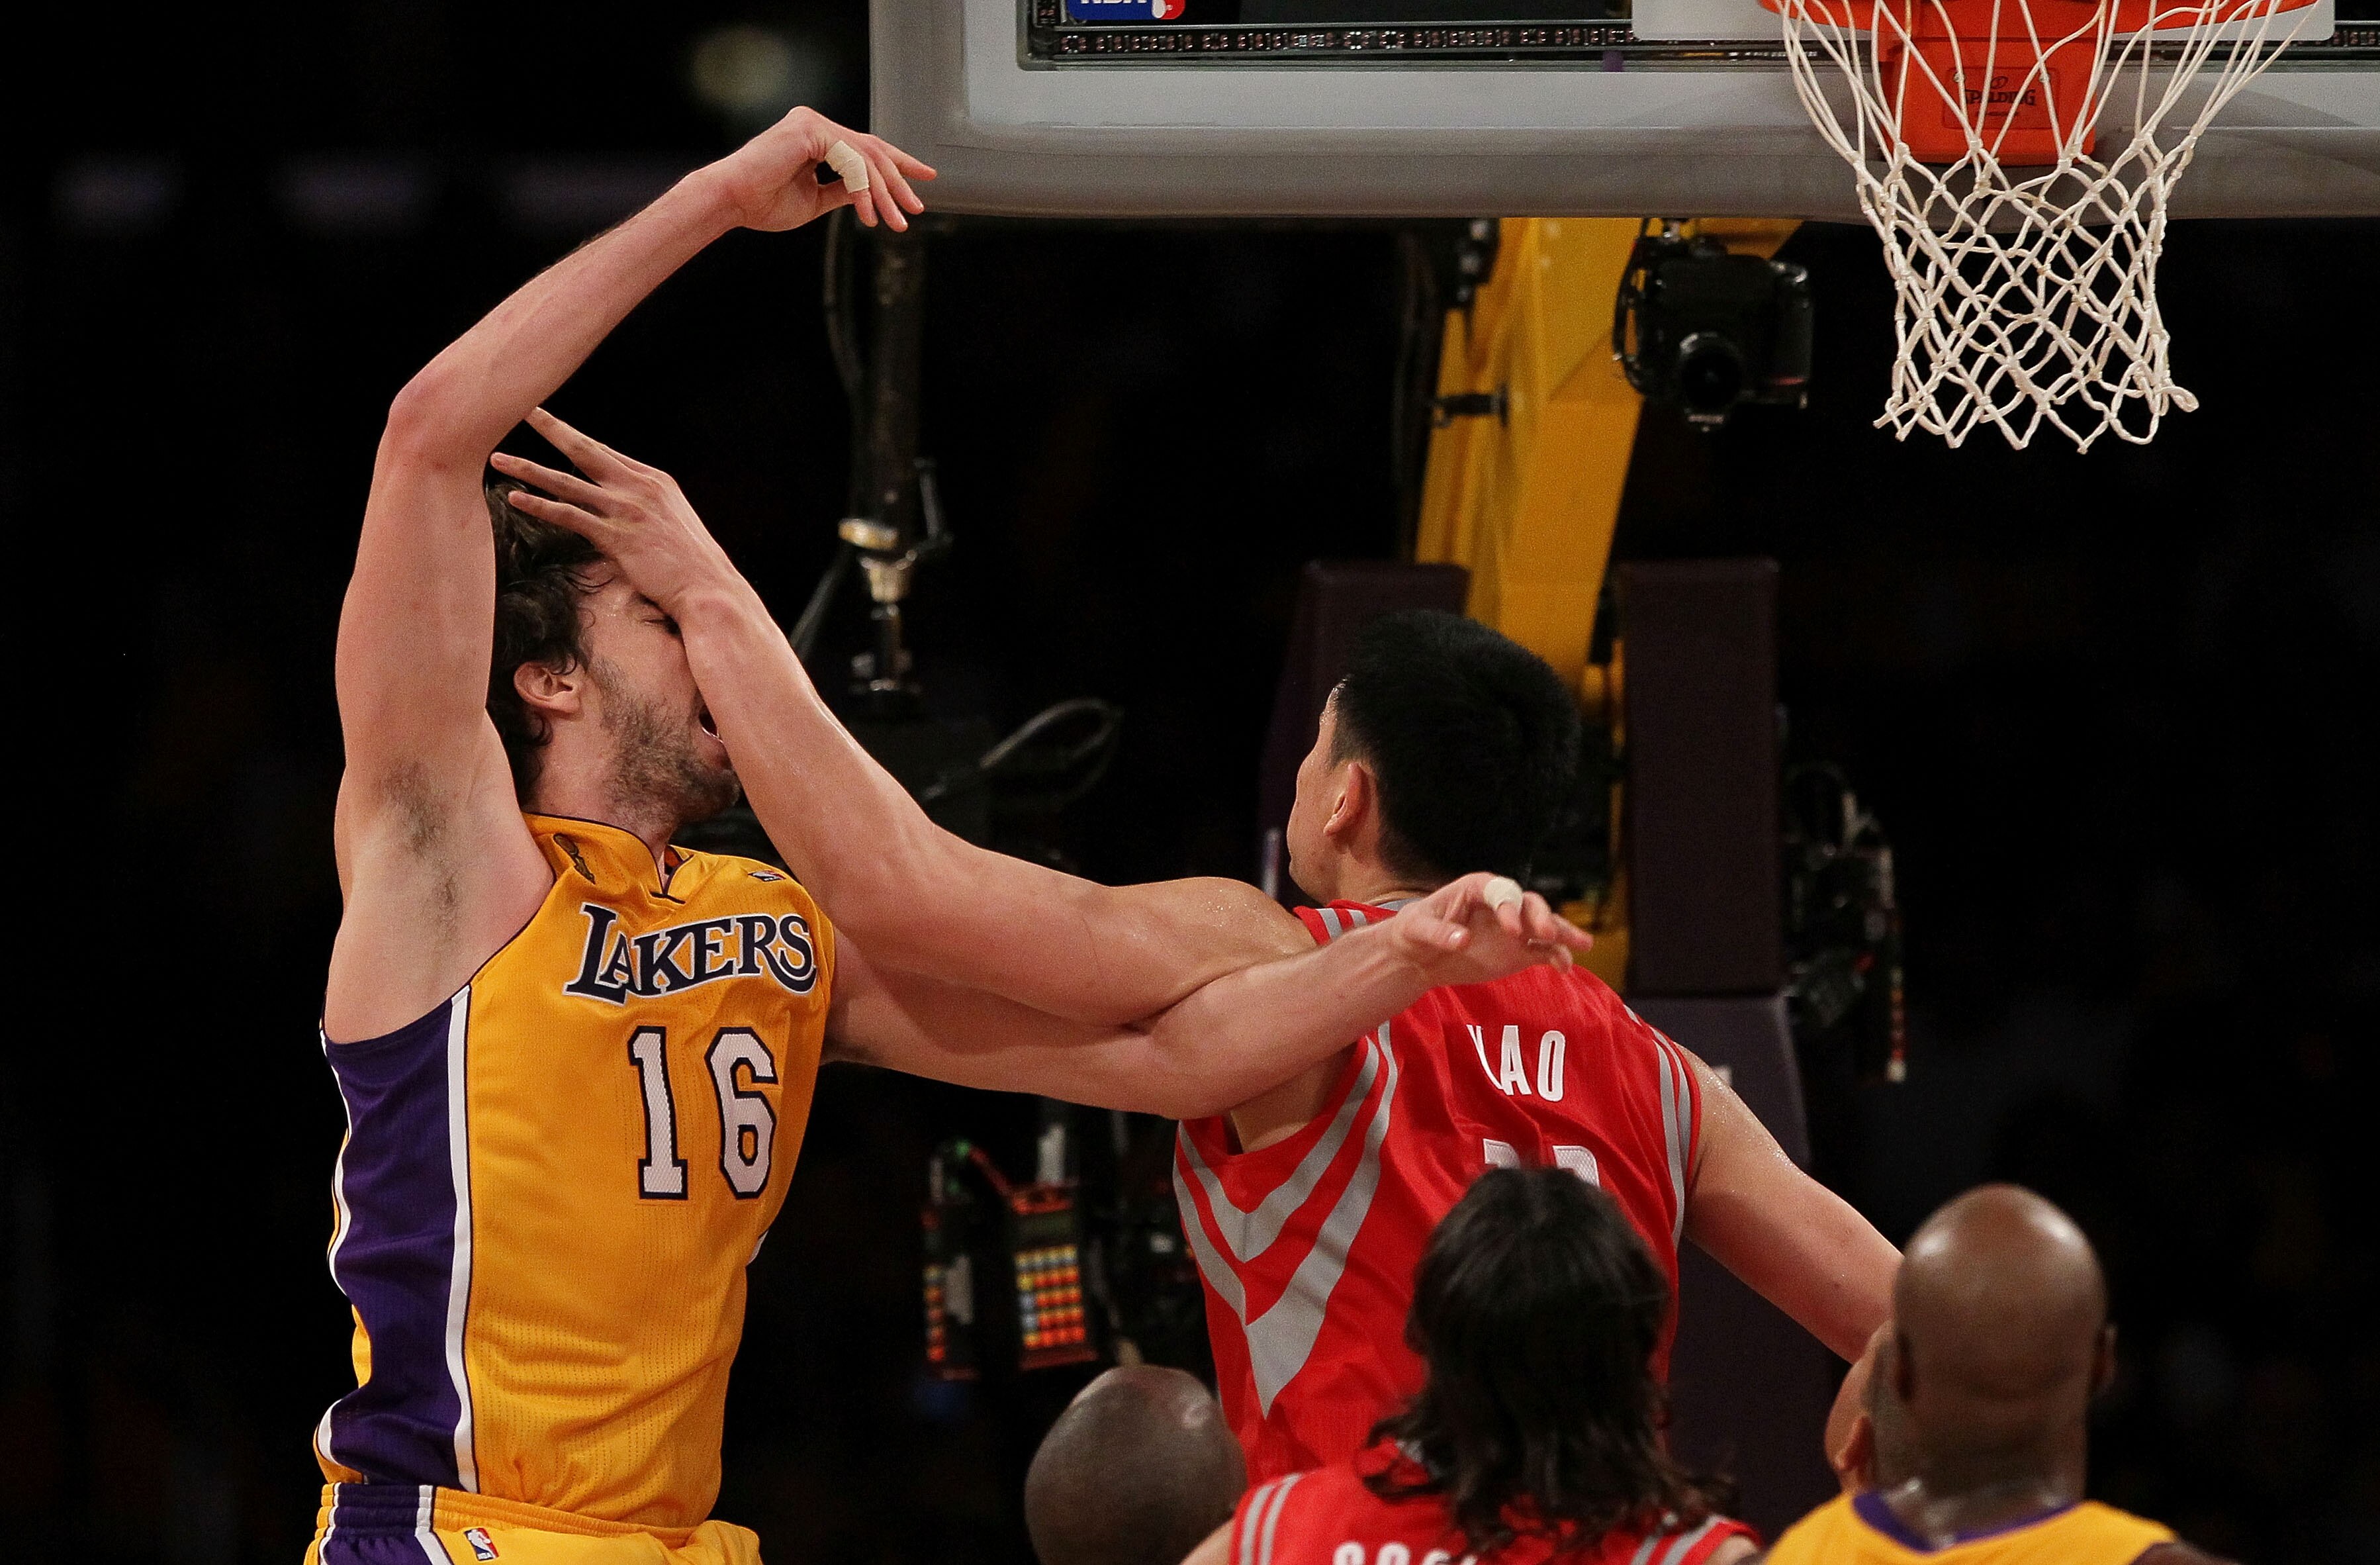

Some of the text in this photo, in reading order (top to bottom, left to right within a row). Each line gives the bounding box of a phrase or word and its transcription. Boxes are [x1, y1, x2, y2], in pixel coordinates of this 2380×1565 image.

[1962, 89, 2037, 106] PLDIG
[563, 902, 817, 1006] LAKERS
[627, 1025, 778, 1200] 16
